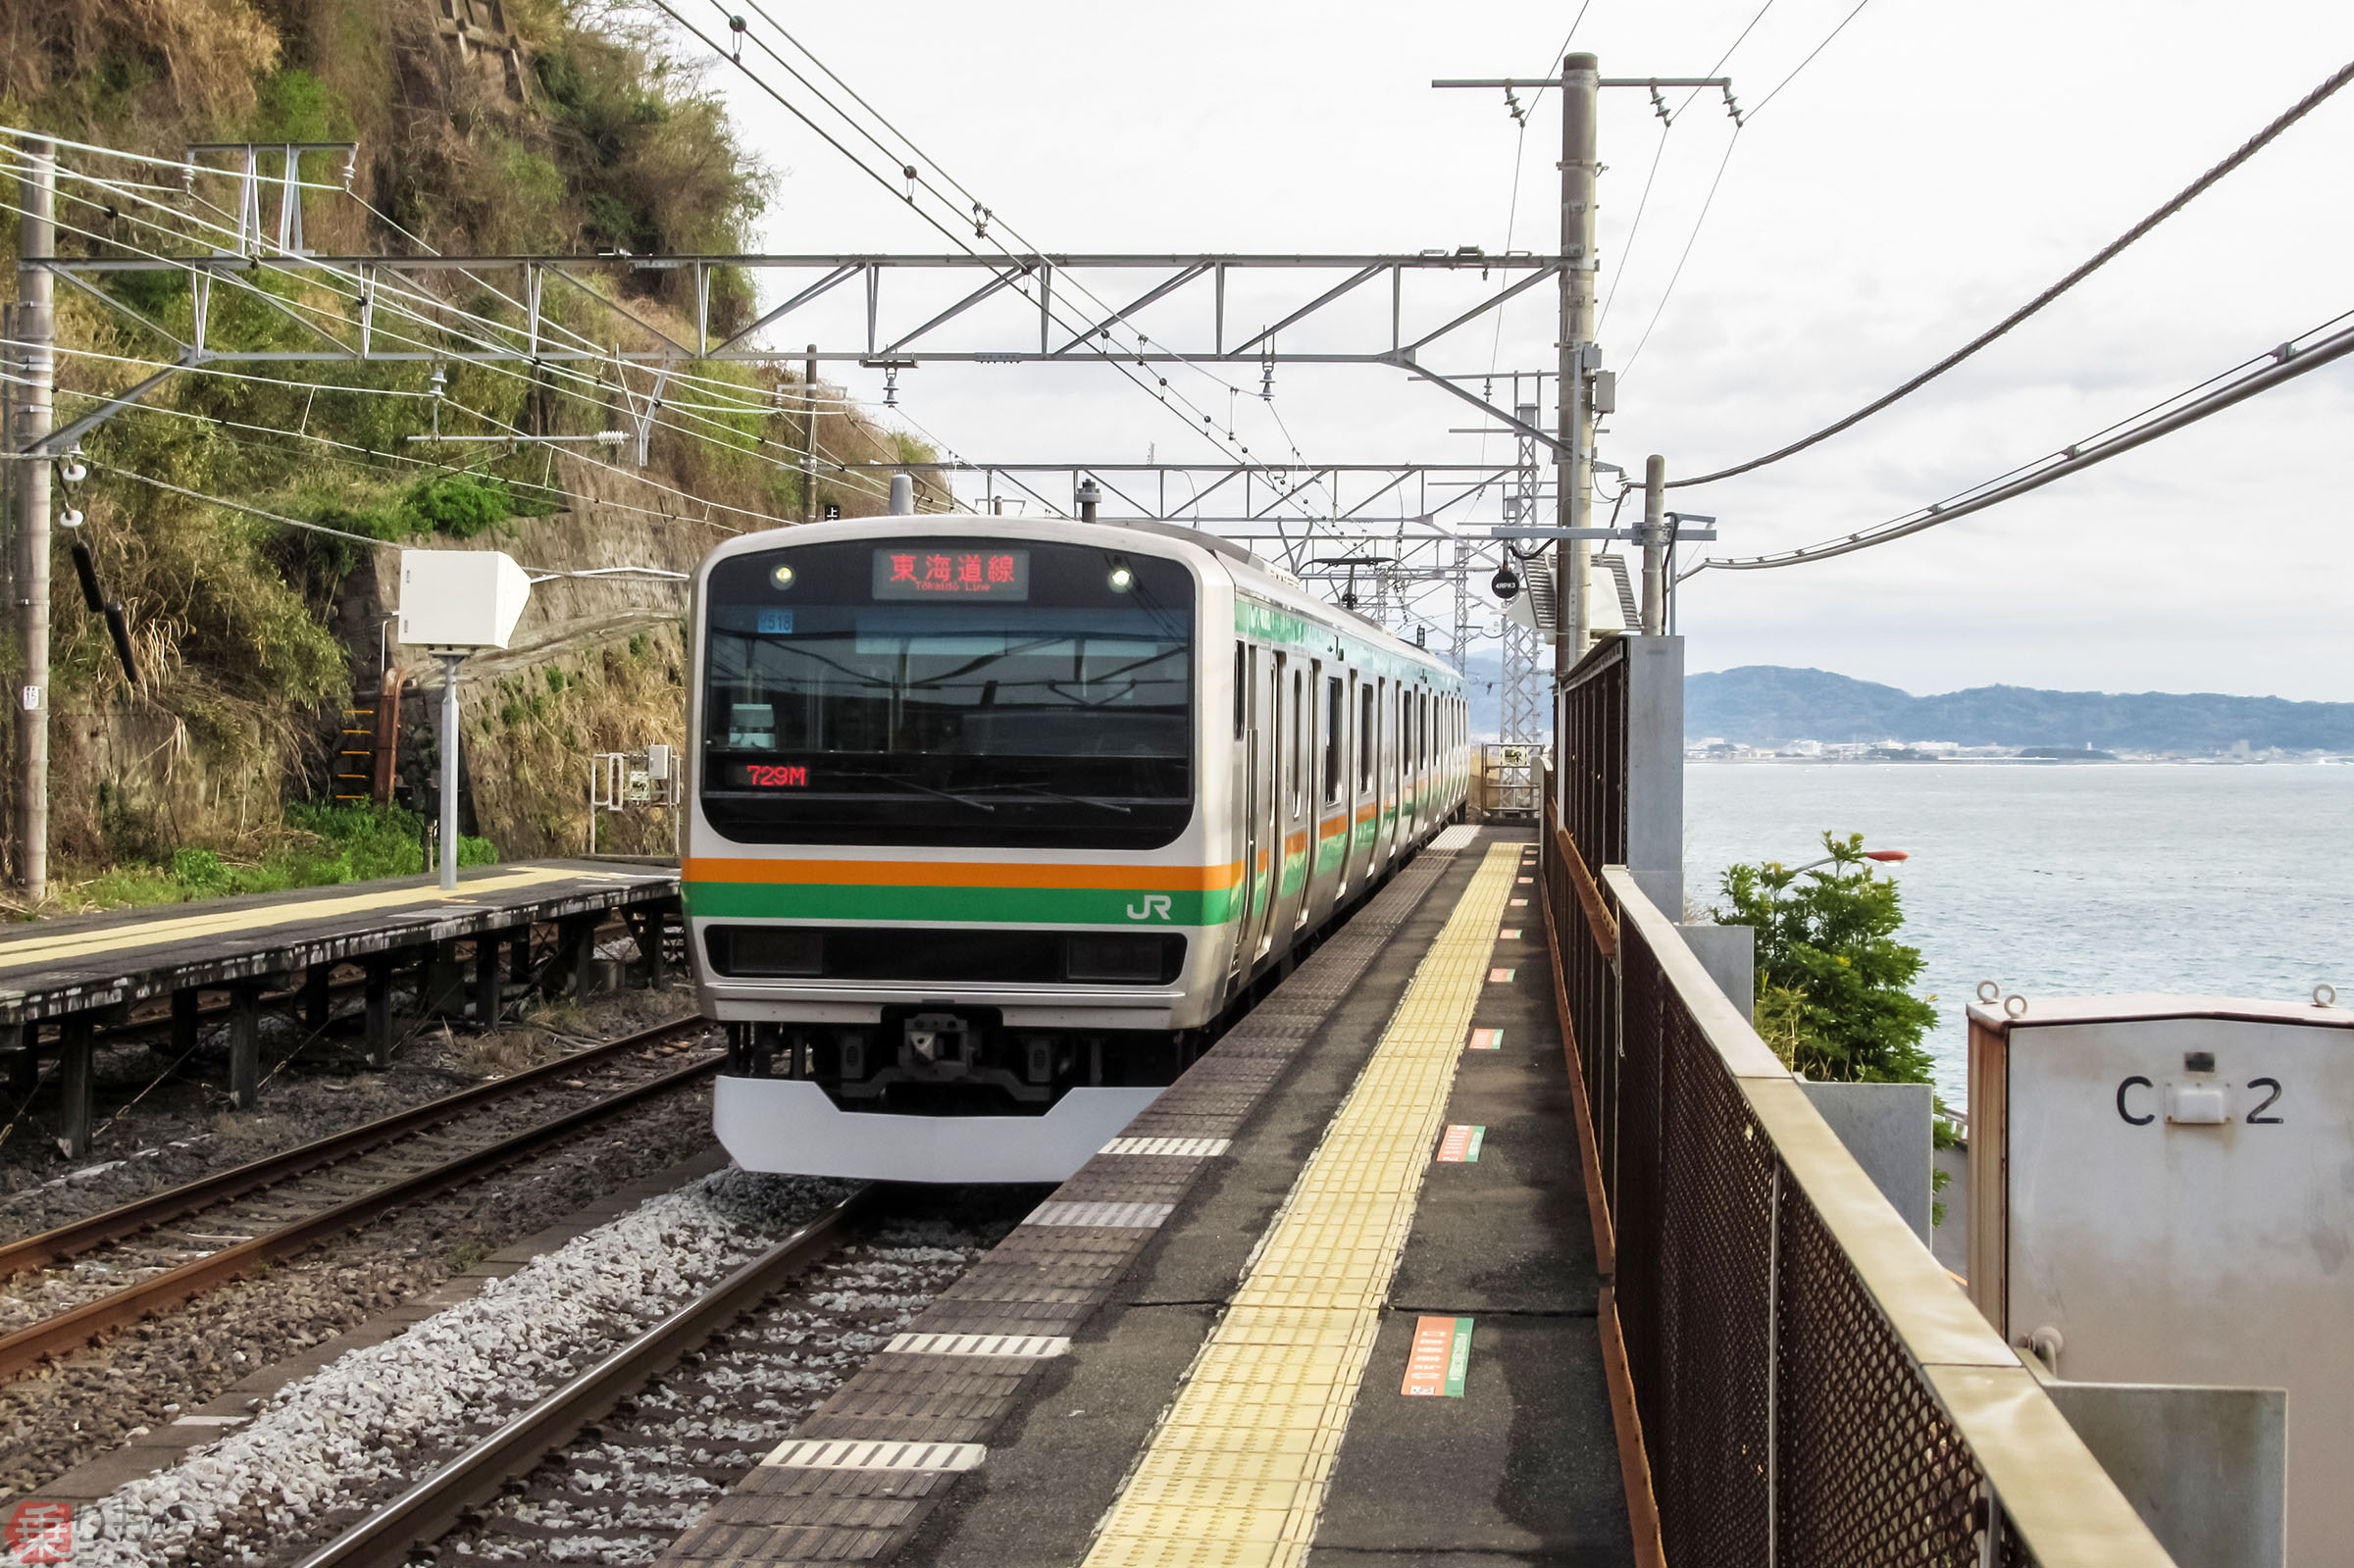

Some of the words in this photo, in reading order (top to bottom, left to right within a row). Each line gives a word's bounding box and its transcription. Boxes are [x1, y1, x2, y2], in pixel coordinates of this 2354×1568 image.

[826, 507, 838, 518] 上
[891, 553, 1015, 582] 東海道線
[747, 765, 806, 785] 729M
[1126, 894, 1172, 920] JR
[2116, 1076, 2155, 1126] C
[2246, 1077, 2284, 1124] 2
